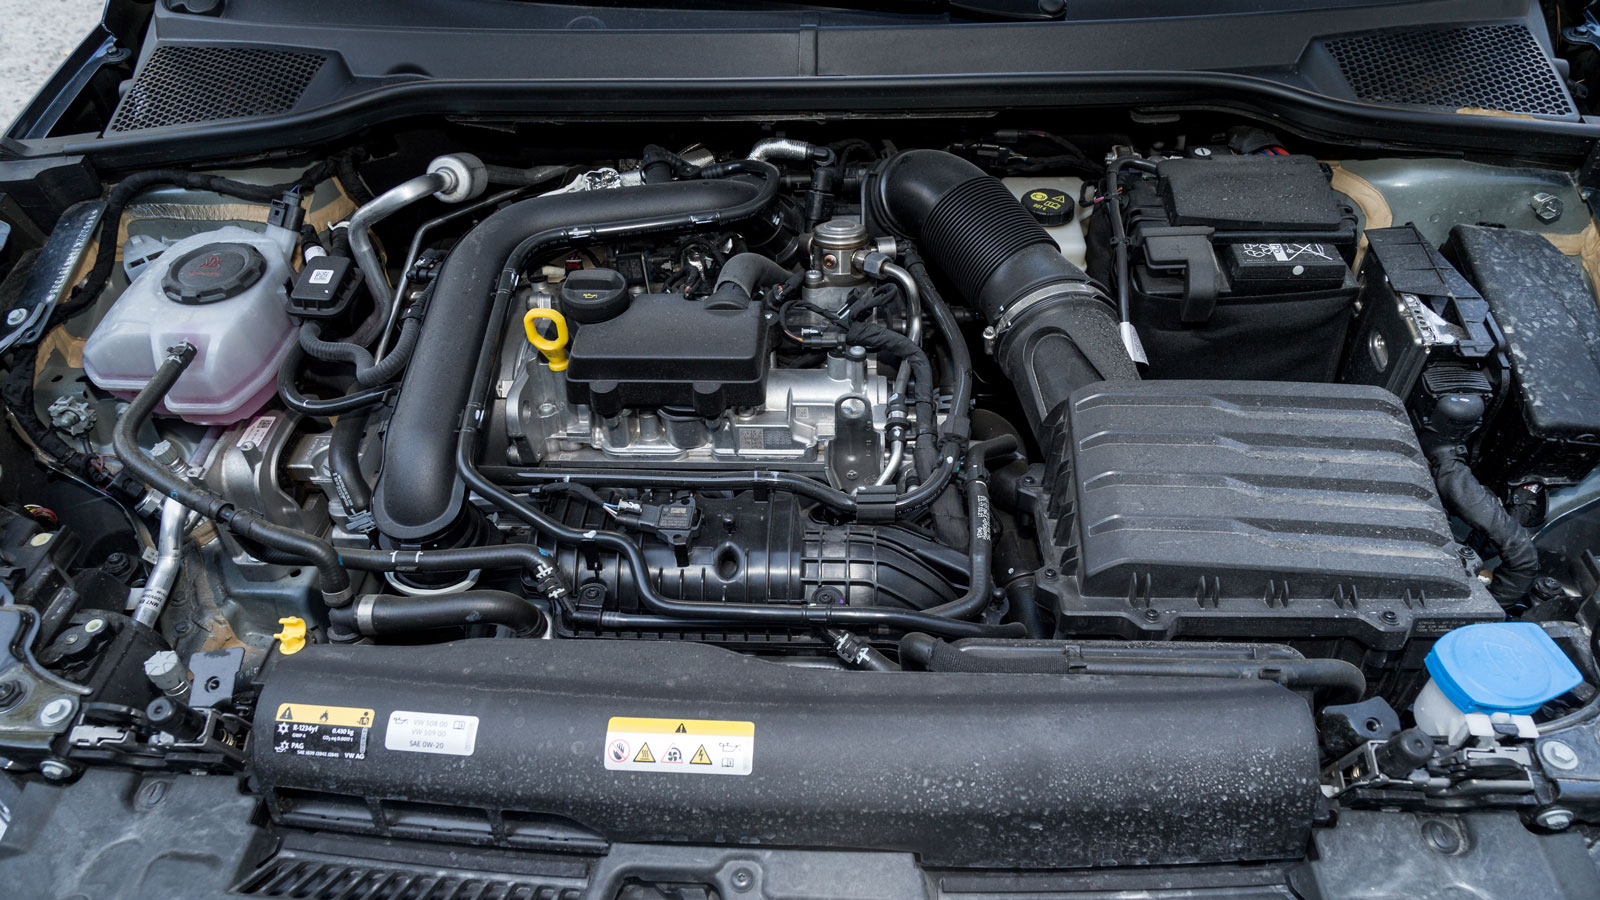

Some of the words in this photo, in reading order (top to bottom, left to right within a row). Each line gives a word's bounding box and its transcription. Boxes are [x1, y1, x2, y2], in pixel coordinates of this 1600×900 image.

[292, 724, 319, 734] R-1234yf
[347, 728, 354, 736] kg
[422, 741, 444, 749] 0W-20
